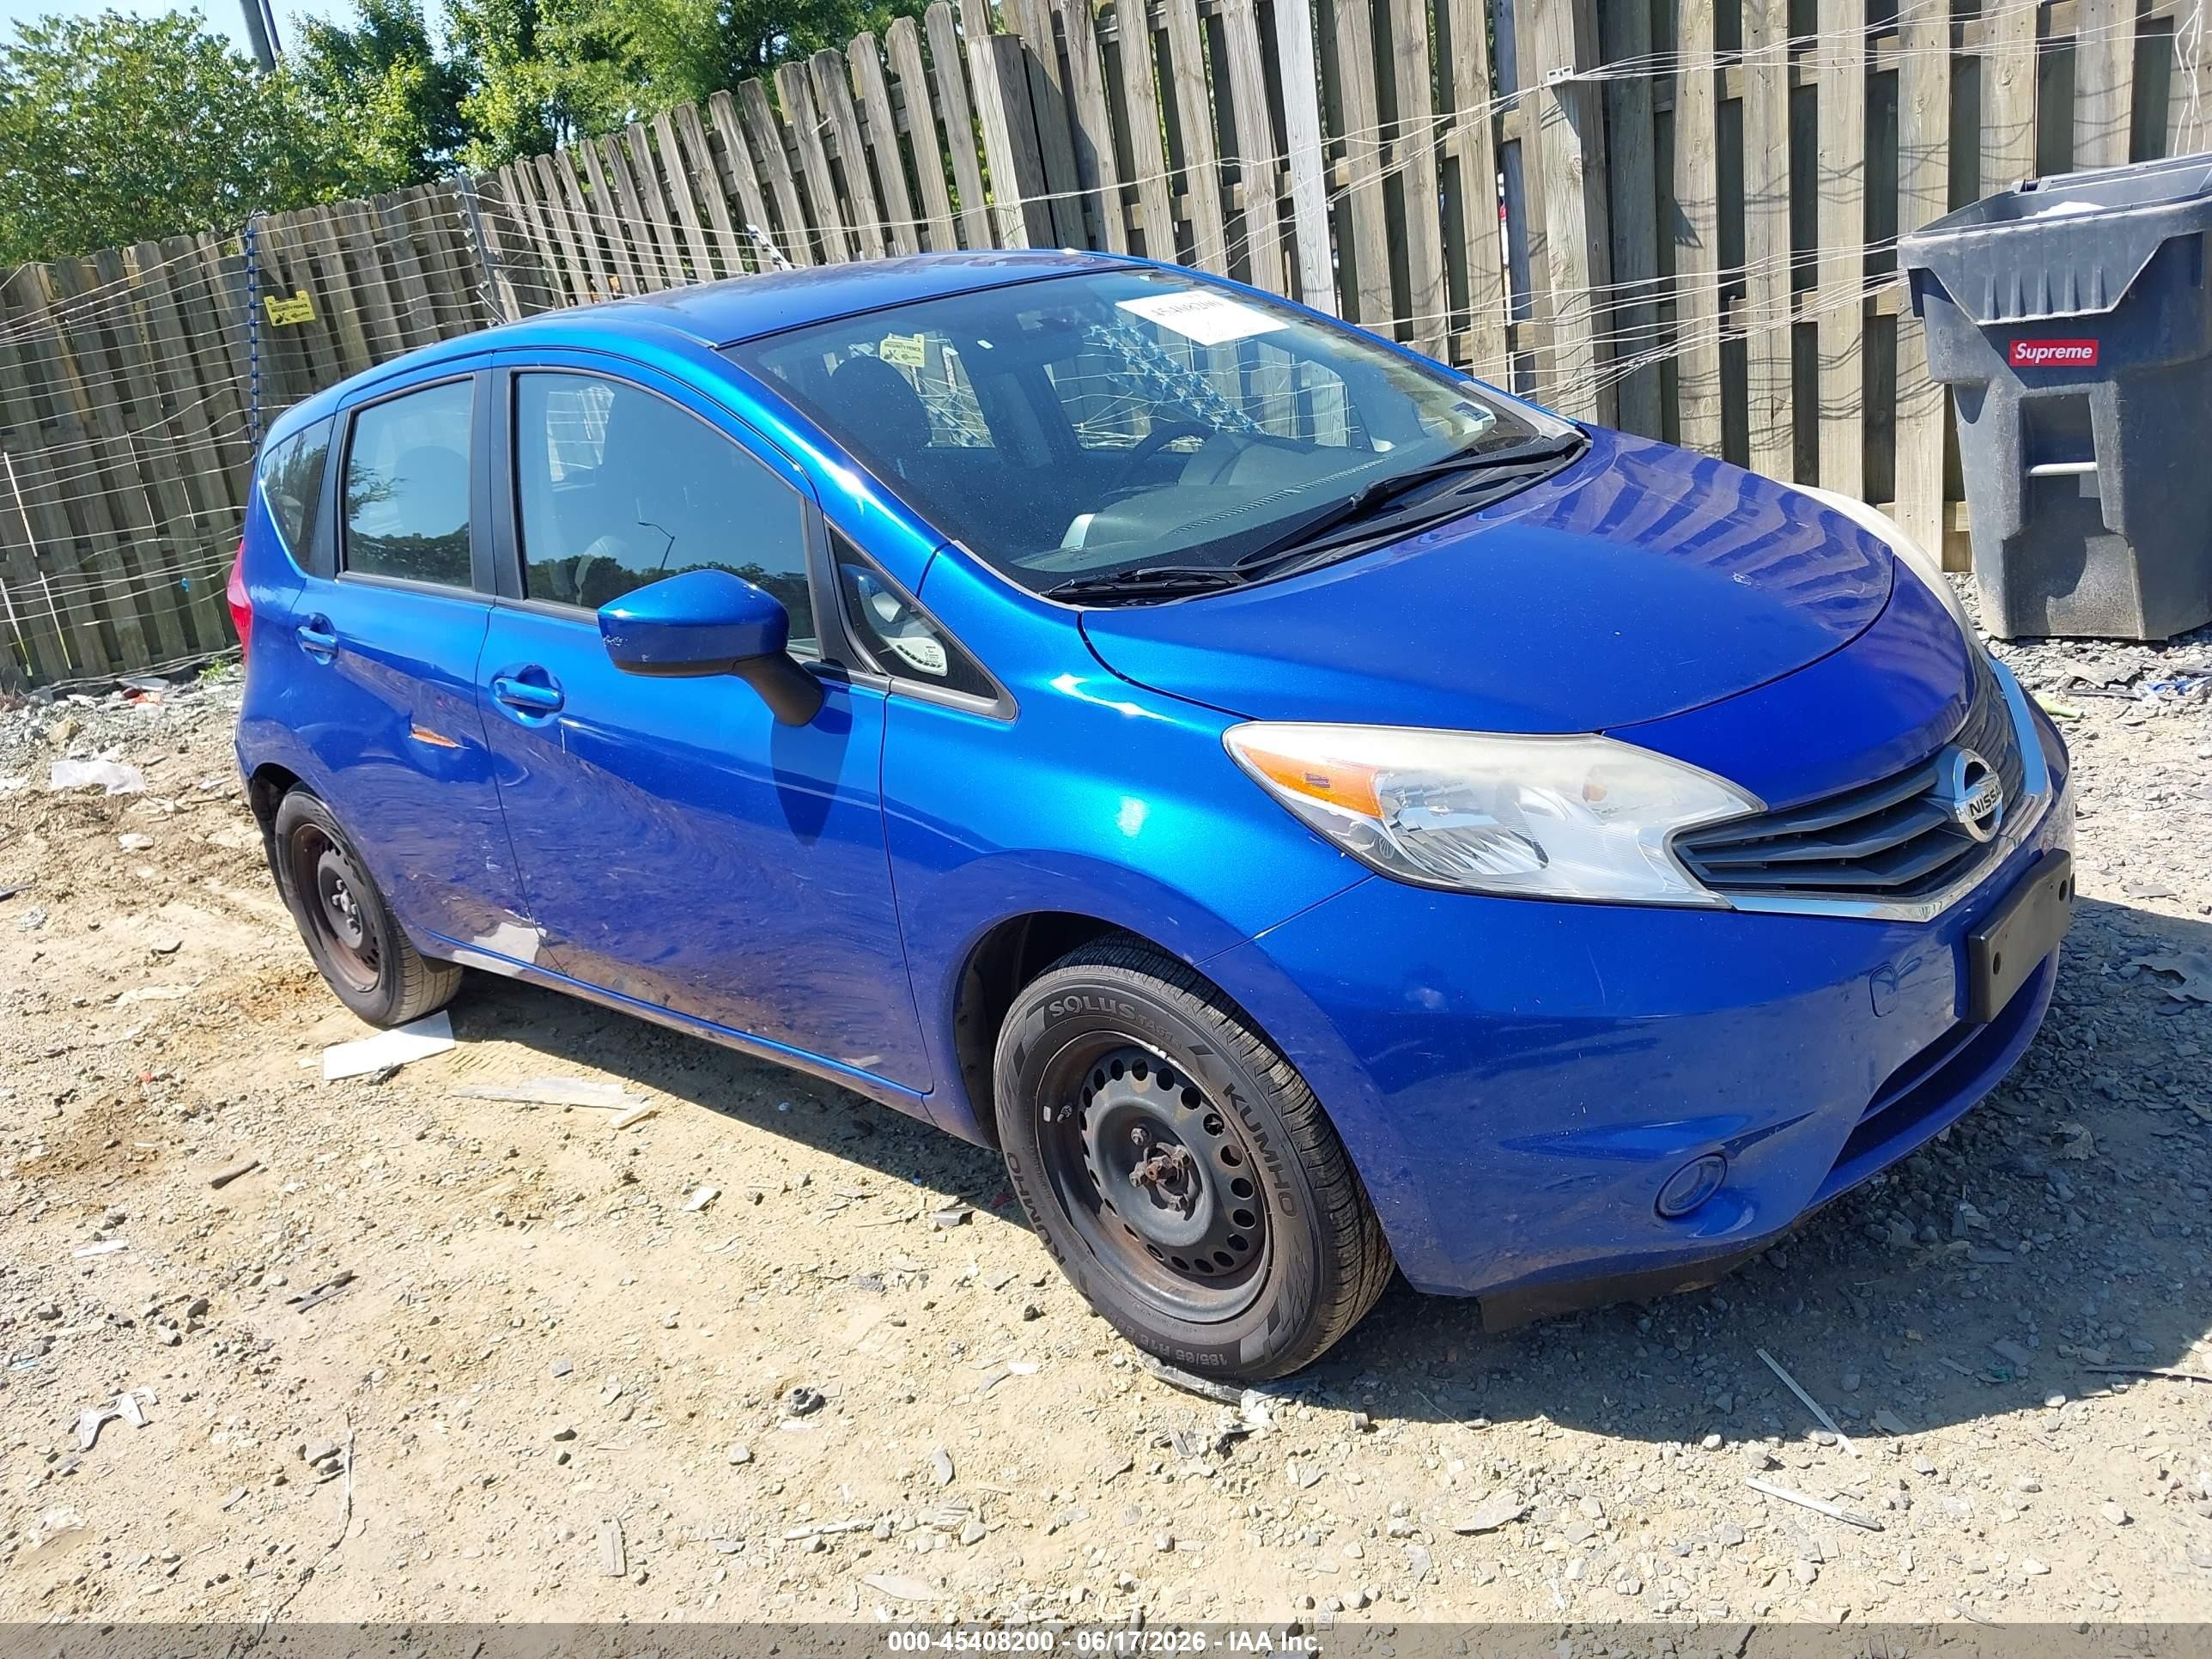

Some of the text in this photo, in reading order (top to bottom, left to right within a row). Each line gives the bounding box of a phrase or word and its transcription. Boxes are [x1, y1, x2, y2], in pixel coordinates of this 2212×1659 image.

[2015, 343, 2093, 364] Supreme
[1969, 783, 2002, 817] NISSA
[1048, 995, 1136, 1020] SOLUS
[1222, 1082, 1297, 1218] KUMHO
[1006, 1152, 1066, 1267] KUMHO
